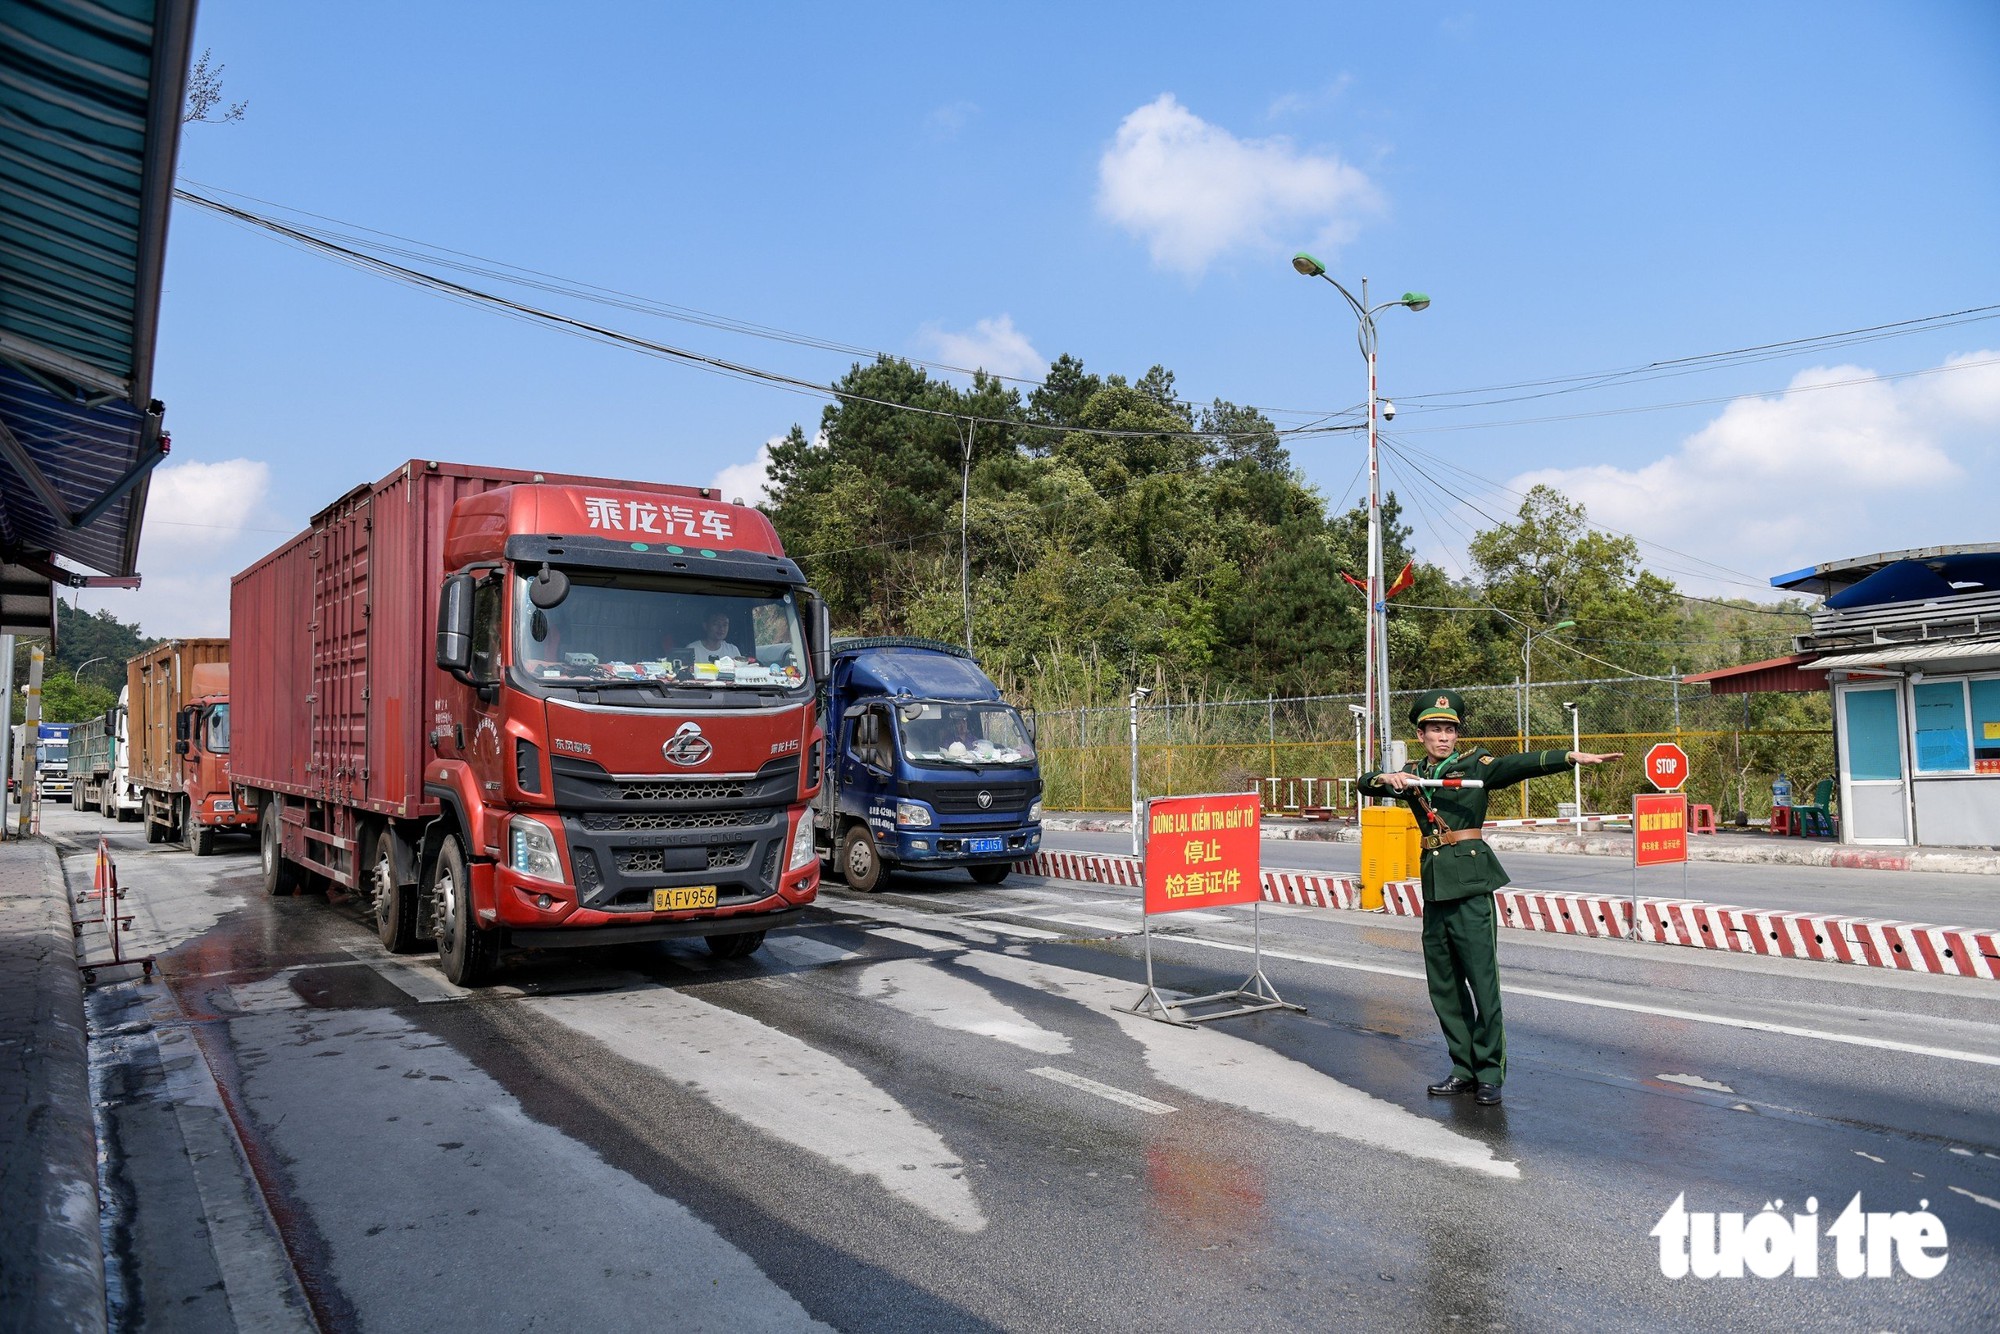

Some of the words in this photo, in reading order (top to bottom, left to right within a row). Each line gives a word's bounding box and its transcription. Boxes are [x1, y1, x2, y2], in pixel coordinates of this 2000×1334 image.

[584, 496, 733, 541] 乘龙汽车
[1655, 758, 1678, 775] STOP
[1191, 805, 1211, 832] KIỂM
[1211, 811, 1225, 830] TRA
[1226, 804, 1242, 829] GIẤY
[1244, 805, 1254, 827] TỜ
[628, 835, 688, 846] CHENG
[700, 832, 743, 843] LONG
[1184, 838, 1222, 865] 停止
[1165, 868, 1241, 899] 检查证件
